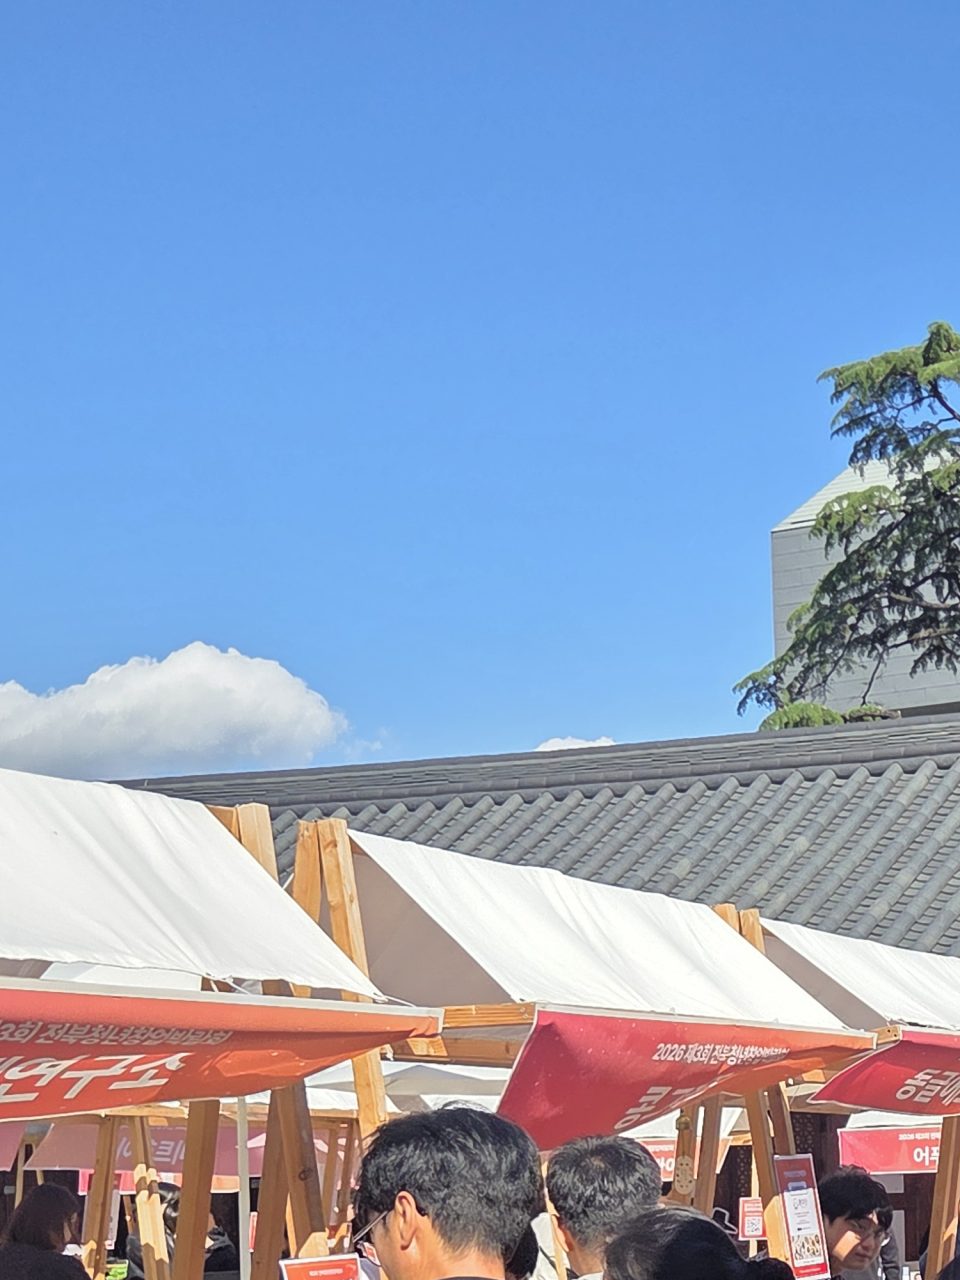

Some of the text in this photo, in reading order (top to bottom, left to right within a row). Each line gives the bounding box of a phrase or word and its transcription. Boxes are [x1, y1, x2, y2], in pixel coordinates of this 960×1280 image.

[0, 1020, 43, 1043] 3회
[652, 1043, 685, 1061] 2026
[0, 1052, 195, 1102] 연구소
